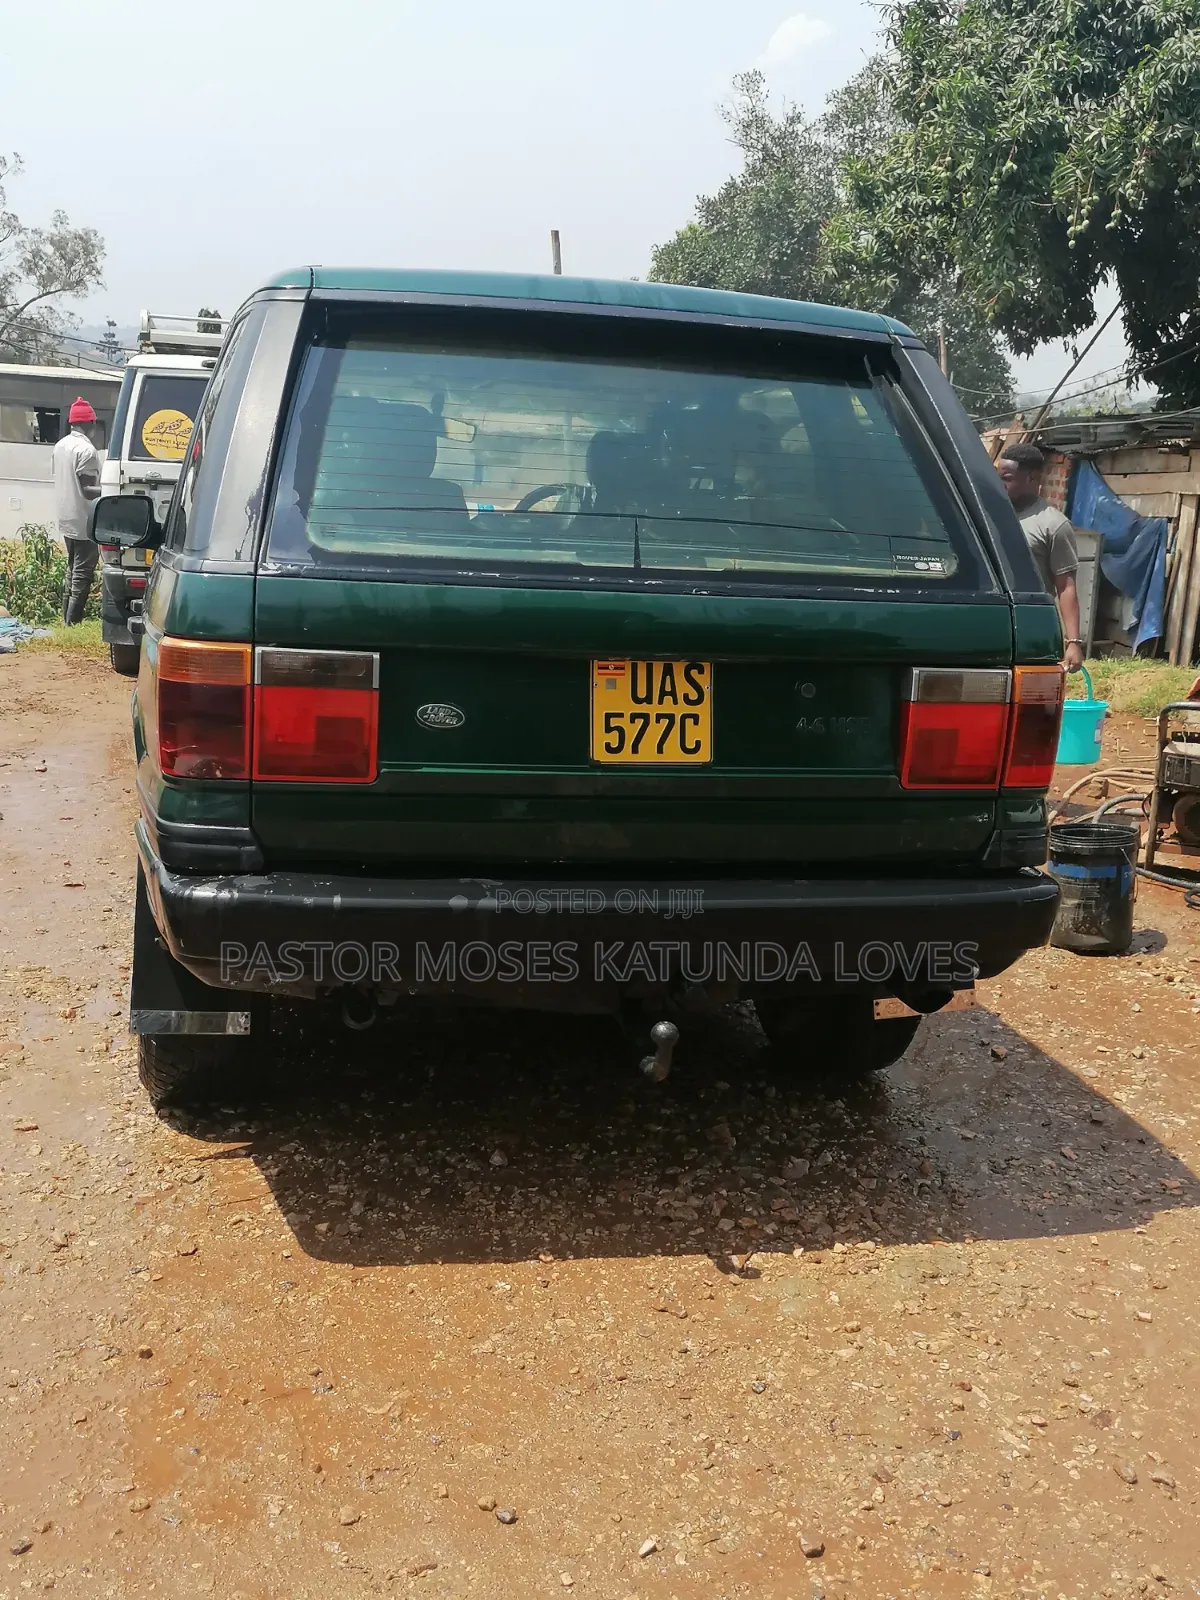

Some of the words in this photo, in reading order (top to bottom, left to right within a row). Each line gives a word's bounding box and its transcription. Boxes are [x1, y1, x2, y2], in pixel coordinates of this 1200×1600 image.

[630, 662, 705, 706] UAS
[427, 706, 451, 716] LAND
[428, 714, 458, 725] ROVER
[604, 712, 702, 755] 577C
